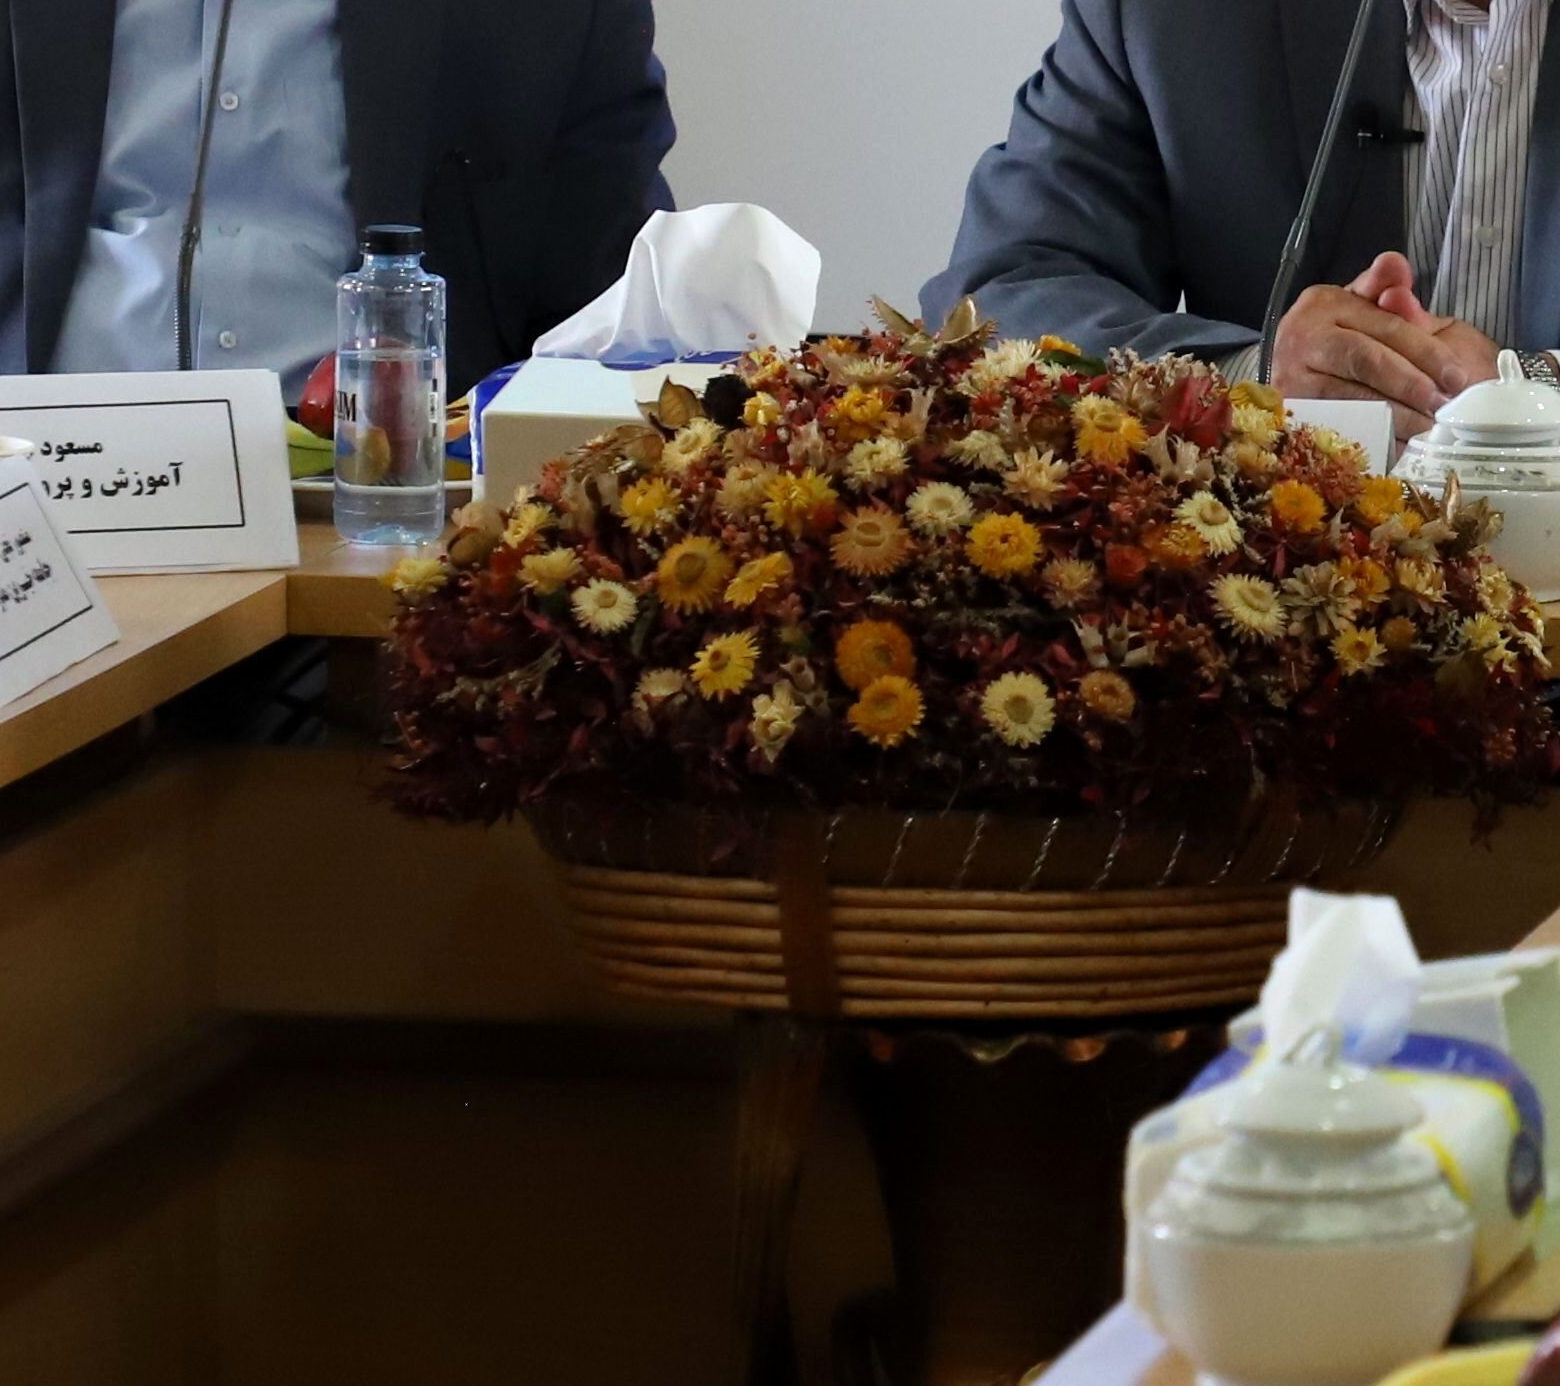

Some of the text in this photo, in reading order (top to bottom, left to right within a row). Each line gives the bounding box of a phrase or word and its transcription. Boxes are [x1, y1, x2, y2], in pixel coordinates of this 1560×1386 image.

[40, 441, 103, 463] مسعود
[80, 478, 93, 499] و
[100, 462, 183, 497] آموزش
